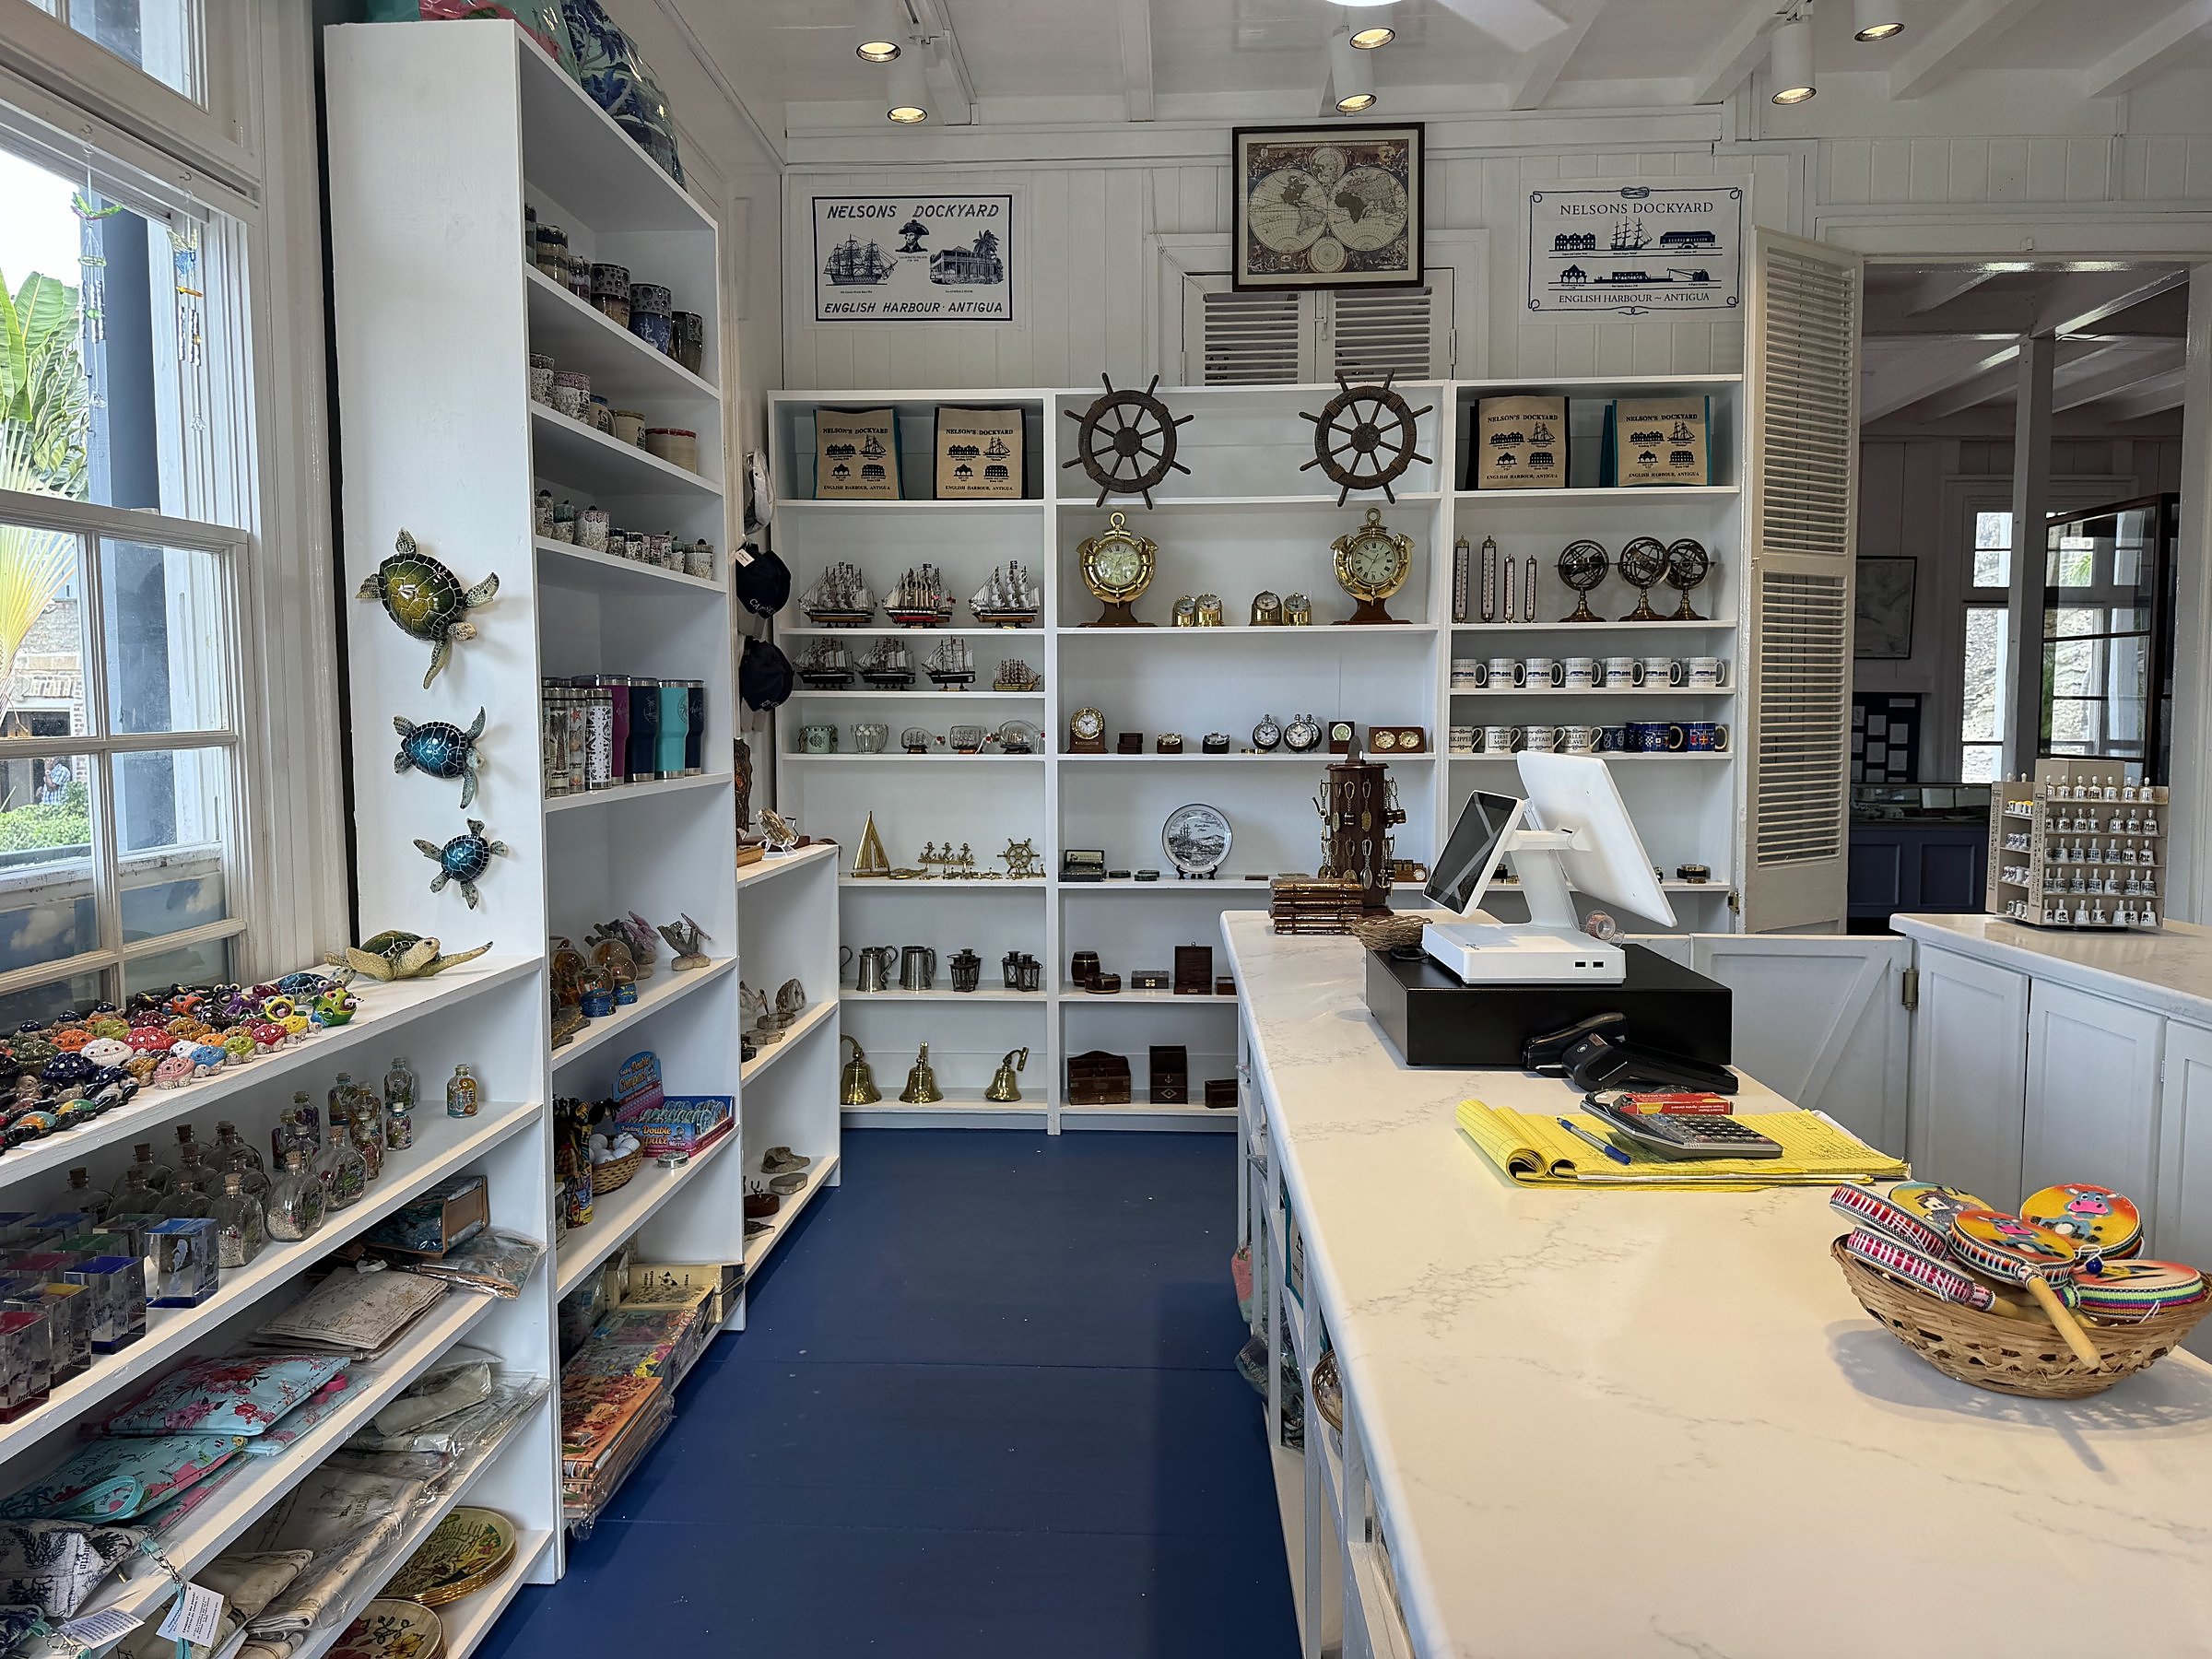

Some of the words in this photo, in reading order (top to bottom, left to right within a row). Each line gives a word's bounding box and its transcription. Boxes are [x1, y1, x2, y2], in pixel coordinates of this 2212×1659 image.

[827, 205, 898, 218] NELSONS
[912, 204, 1000, 218] DOCKYARD
[1560, 204, 1628, 216] NELSONS
[1633, 202, 1714, 215] DOCKYARD
[1559, 294, 1601, 303] ENGLISH
[1604, 293, 1653, 303] HARBOUR
[1664, 292, 1710, 302] ANTIGUA
[824, 302, 877, 313] ENGLISH
[882, 301, 941, 313] HARBOUR
[947, 301, 1003, 313] ANTIGUA
[1487, 415, 1520, 423] NELSON'S
[854, 427, 888, 435] DOCKYARD
[978, 429, 1014, 437] DOCKYARD
[641, 1125, 671, 1135] Double
